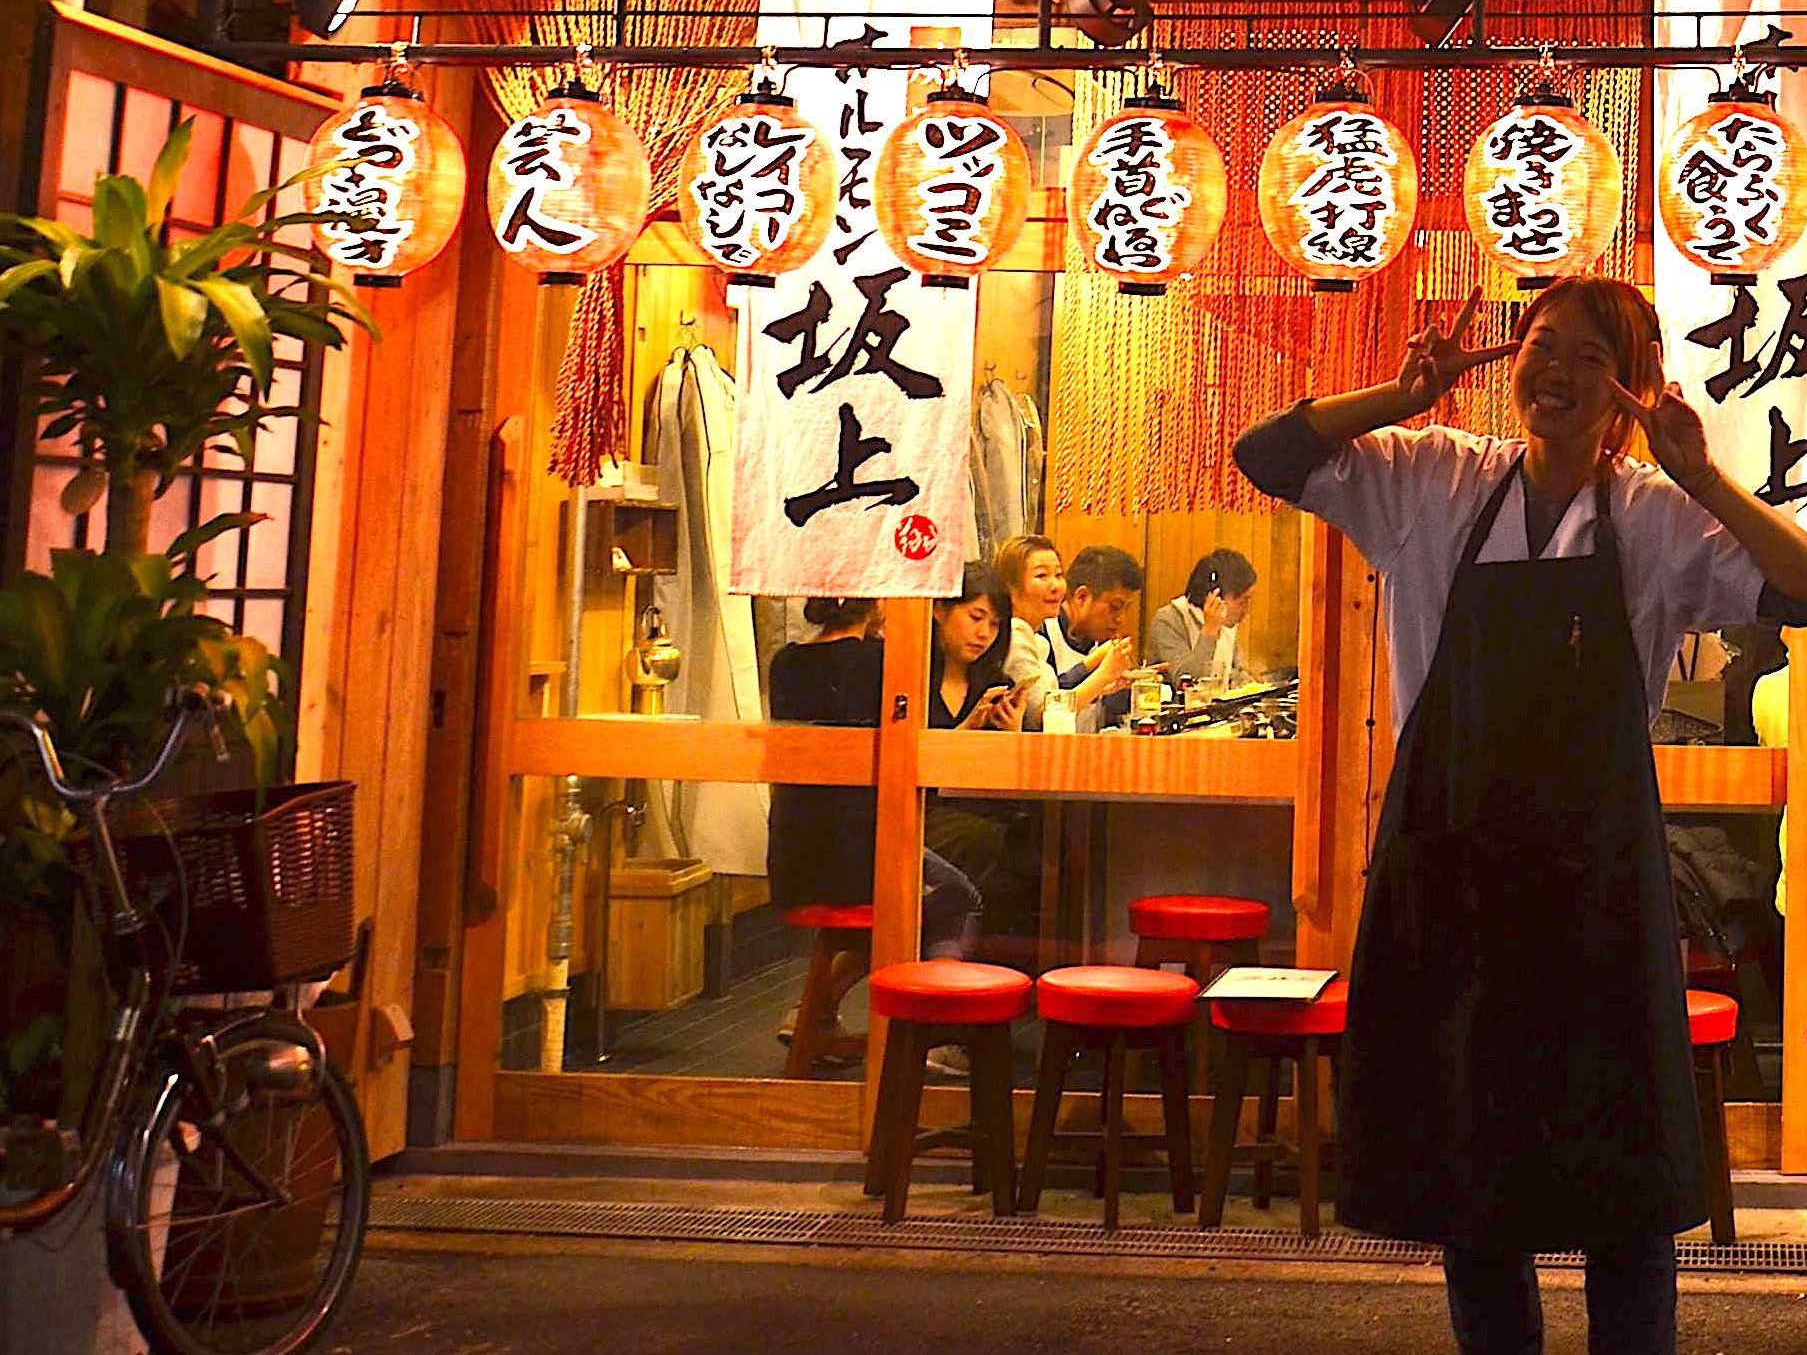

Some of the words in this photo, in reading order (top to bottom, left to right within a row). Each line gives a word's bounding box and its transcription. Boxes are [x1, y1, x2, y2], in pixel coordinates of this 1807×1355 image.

[502, 114, 581, 246] 芸人
[917, 122, 1000, 257] ツッコミ
[1302, 116, 1388, 262] 猛虎打線
[1487, 120, 1572, 255] 焼きまっせ
[763, 266, 945, 528] 坂上
